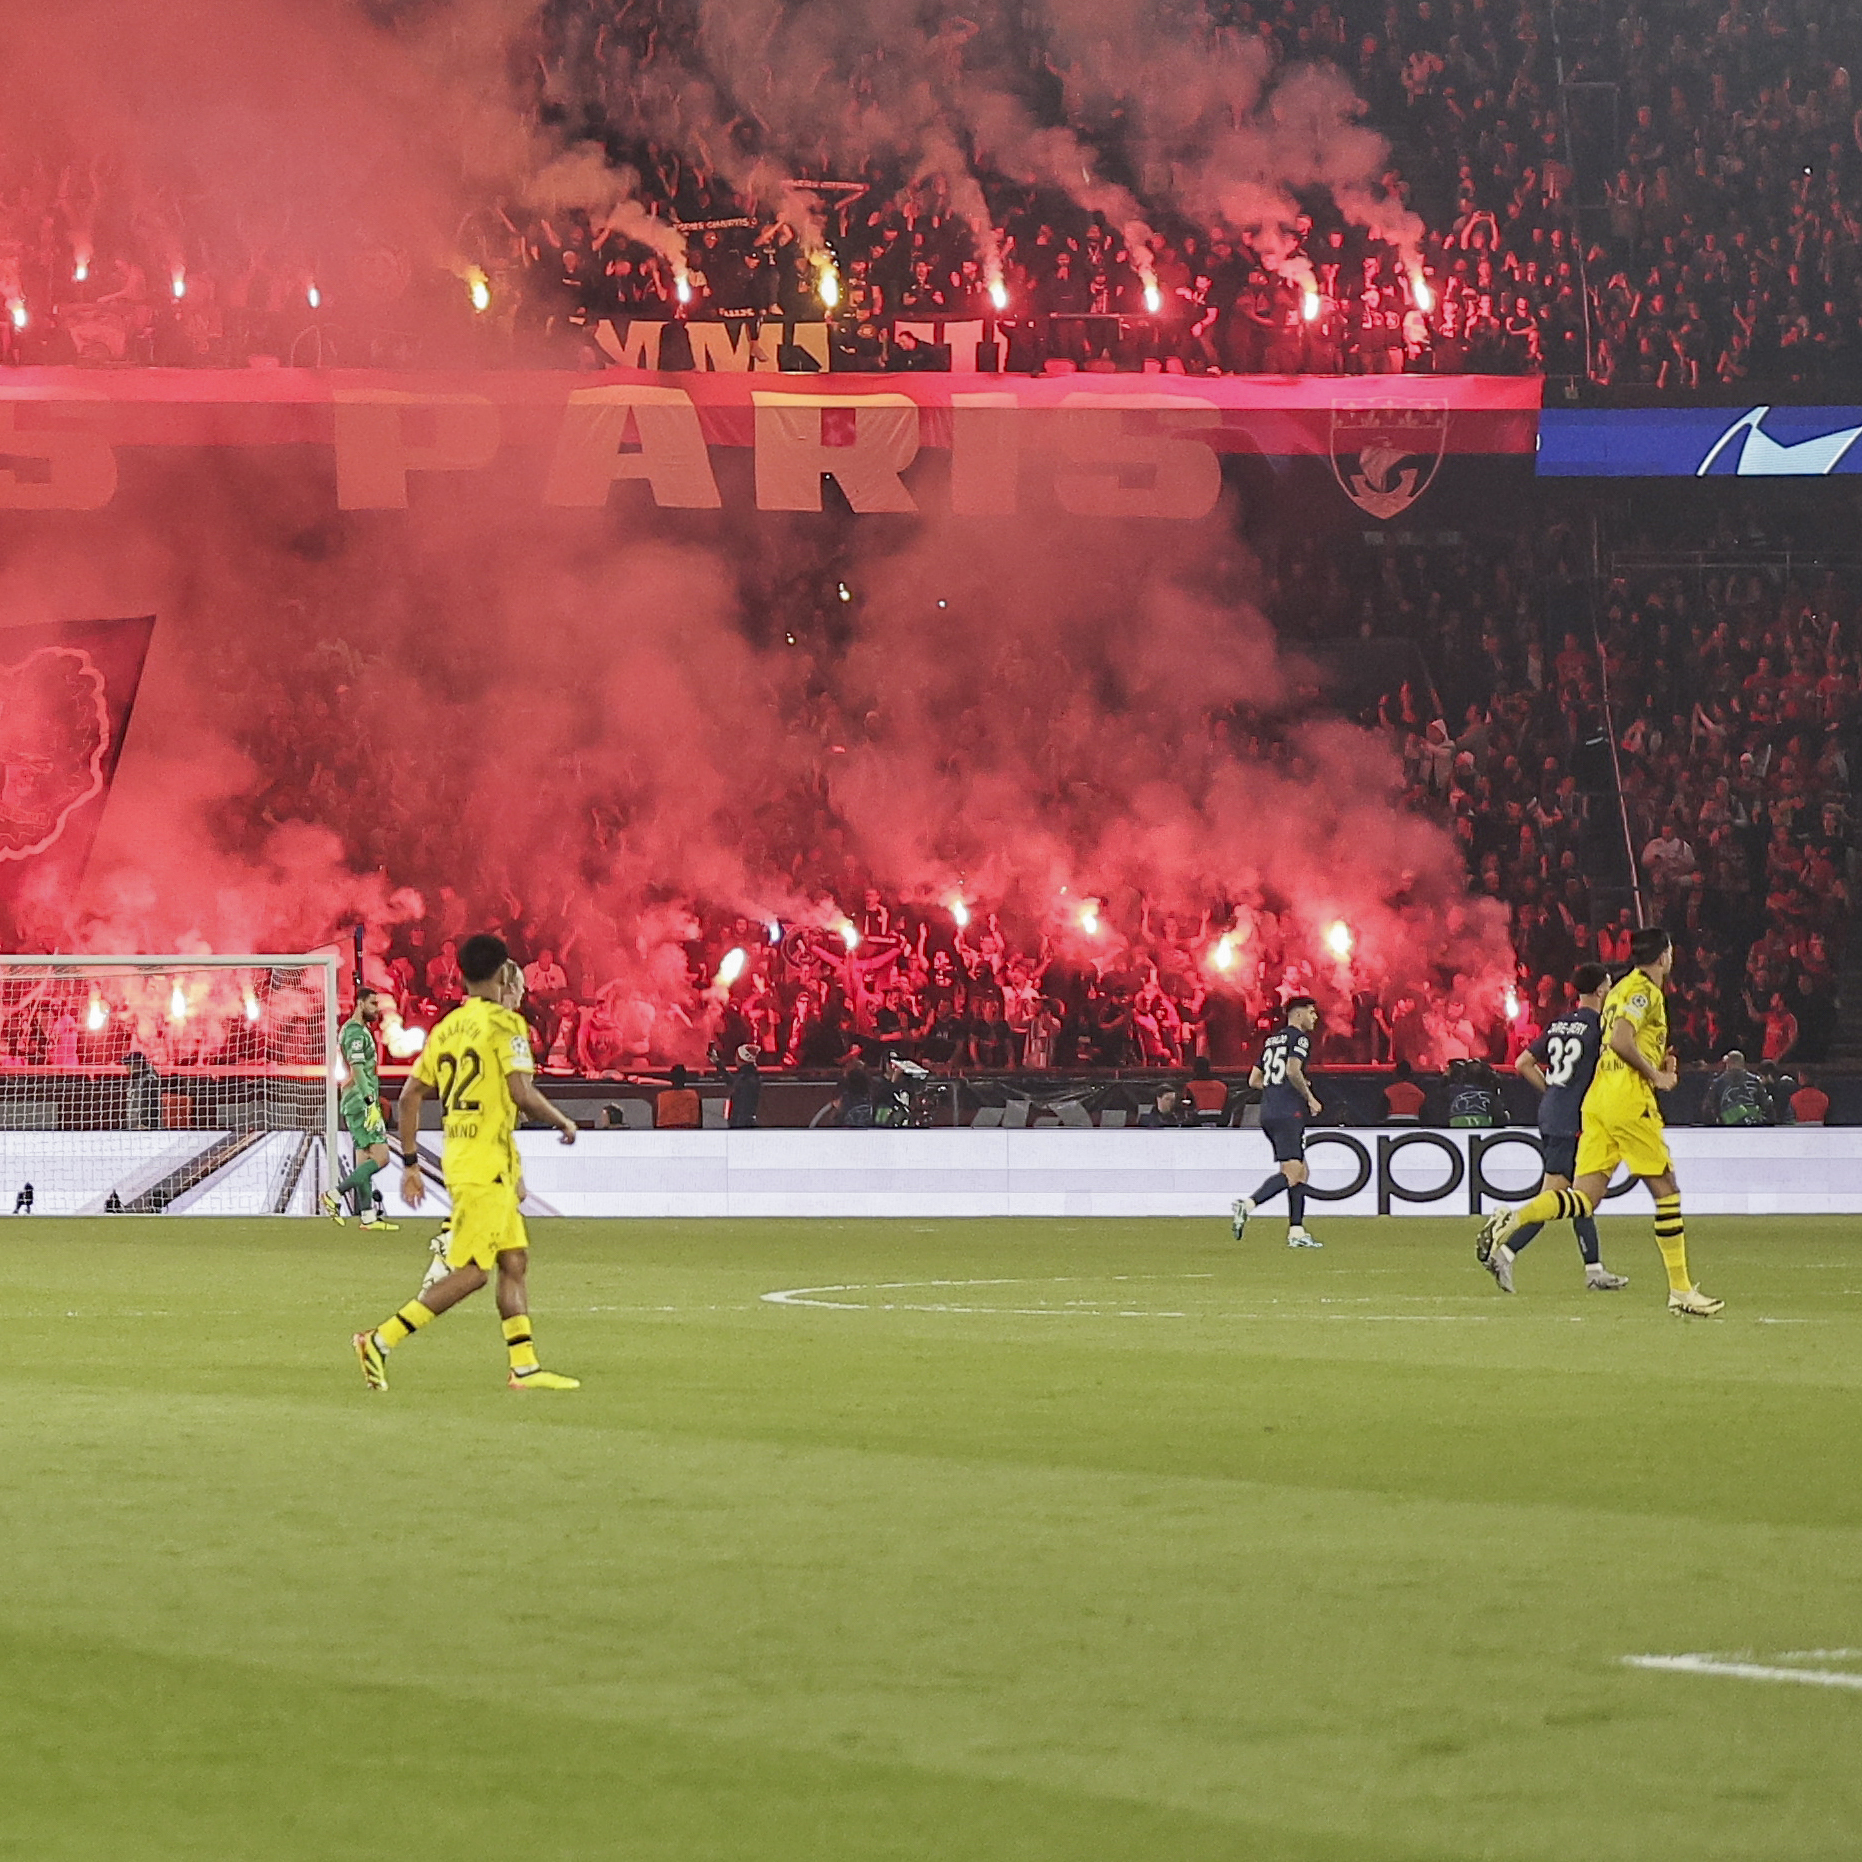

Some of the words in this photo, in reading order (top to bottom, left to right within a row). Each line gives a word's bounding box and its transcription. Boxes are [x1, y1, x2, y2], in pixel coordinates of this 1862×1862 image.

[332, 384, 1222, 520] PARIS
[437, 1047, 481, 1116] 22
[1263, 1046, 1287, 1086] 35
[1546, 1037, 1582, 1087] 33
[1304, 1131, 1639, 1216] opp
